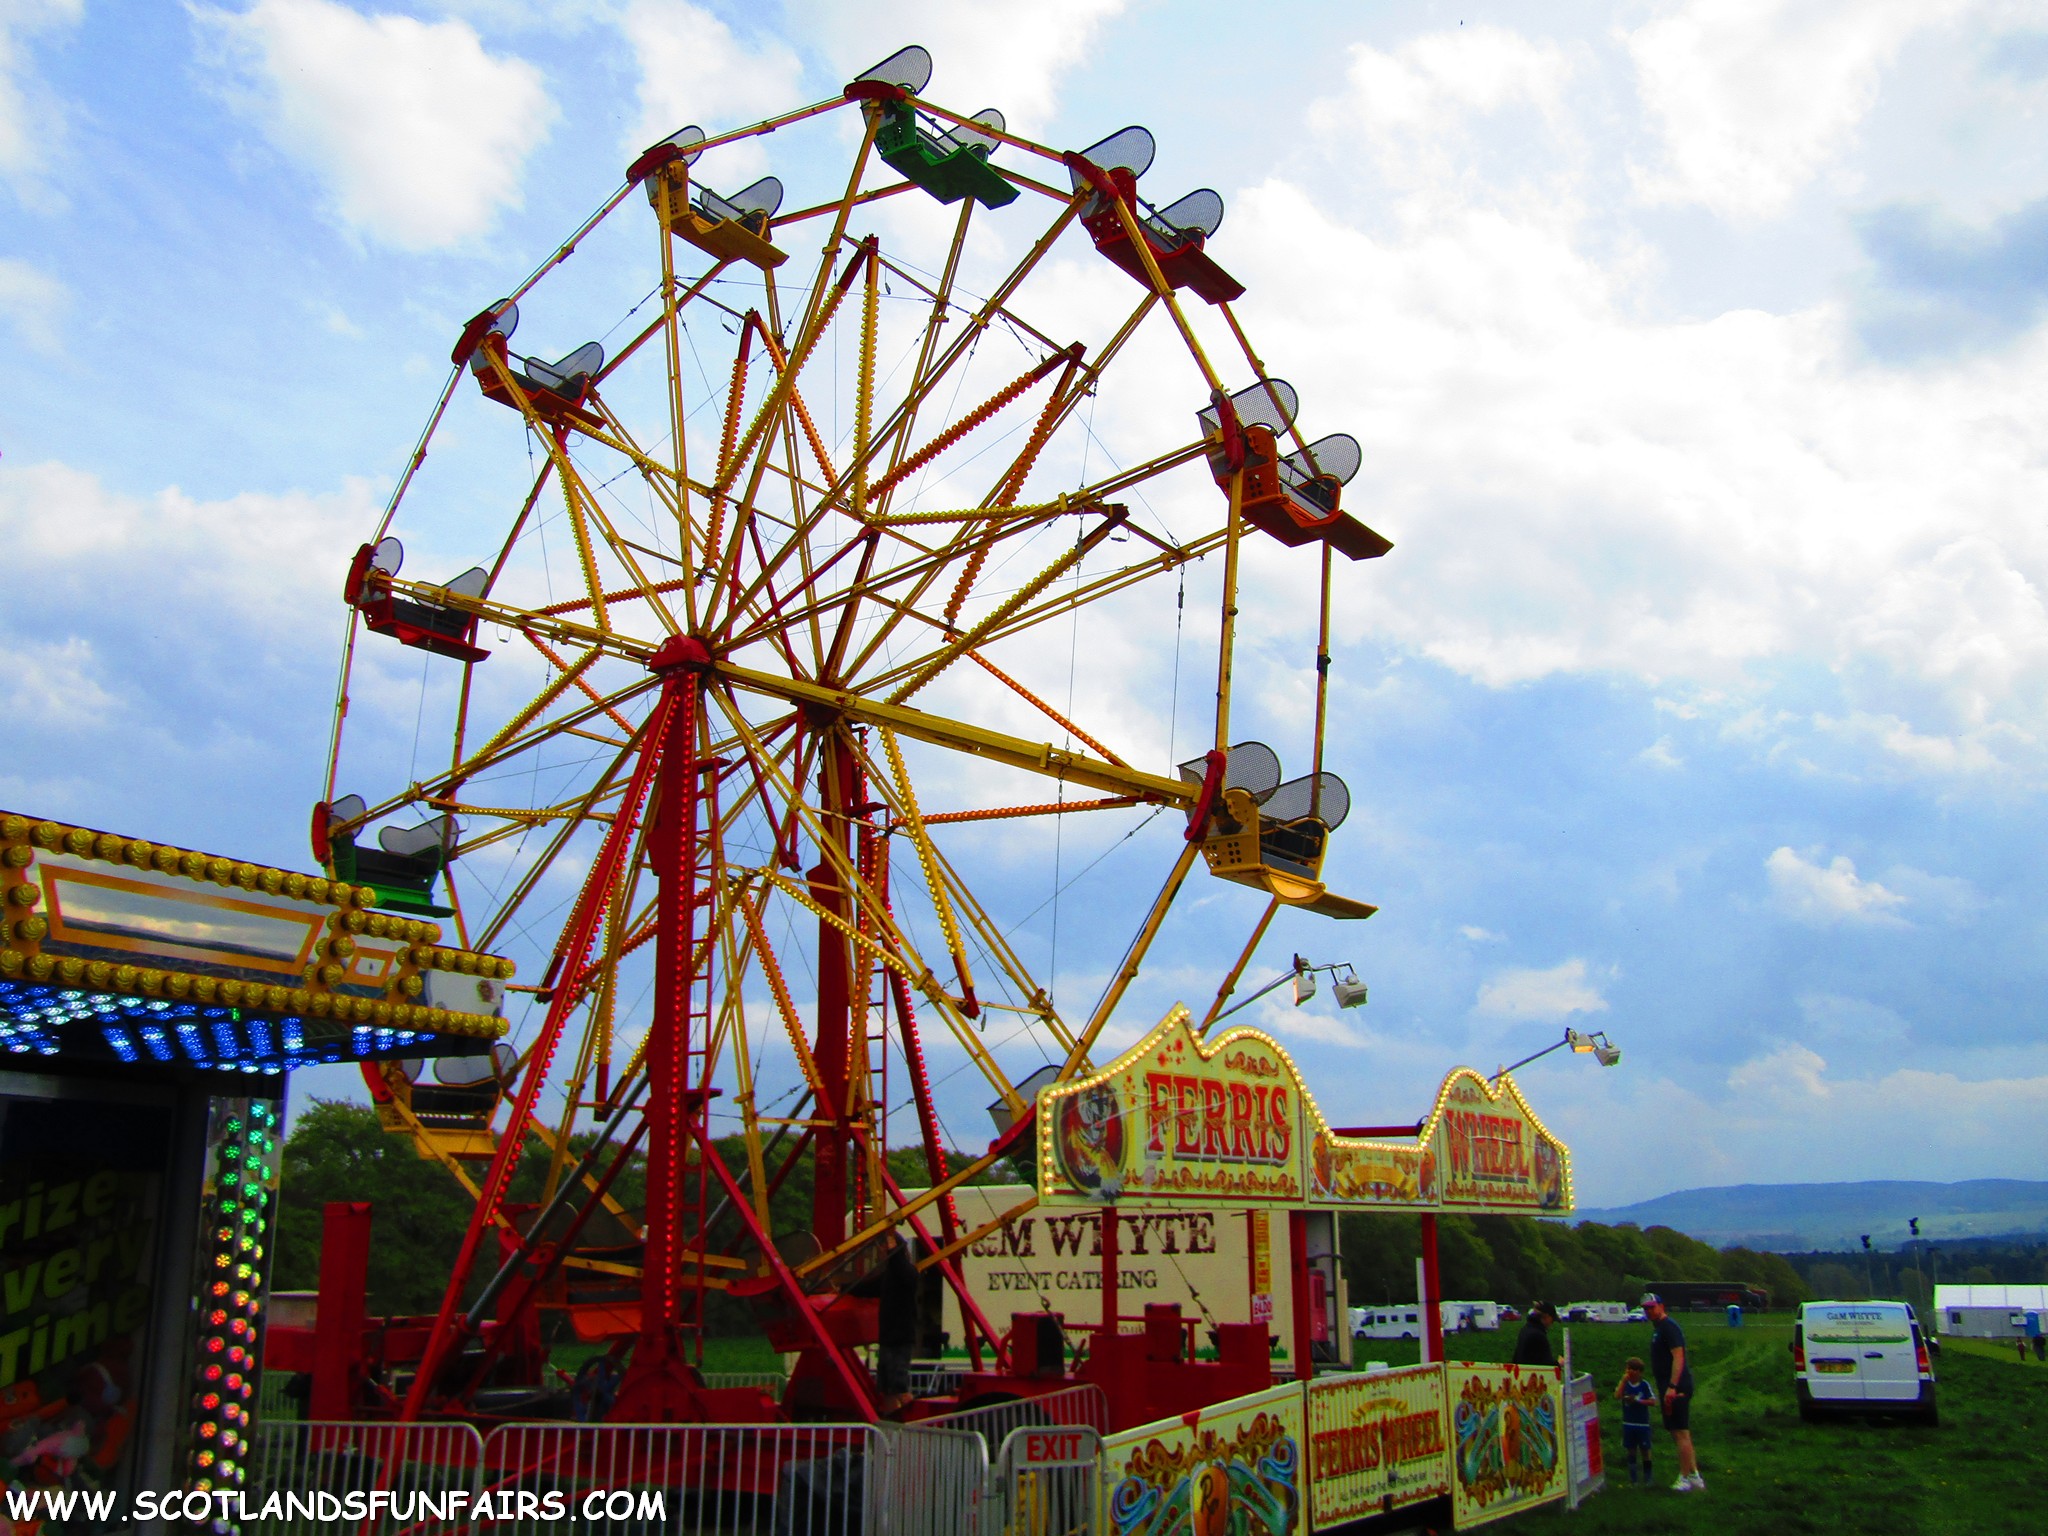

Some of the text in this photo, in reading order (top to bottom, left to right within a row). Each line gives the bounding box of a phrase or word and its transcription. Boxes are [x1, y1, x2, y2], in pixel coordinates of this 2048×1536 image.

[1144, 1072, 1530, 1180] FERRIS WHEEL
[957, 1217, 1036, 1258] &M
[988, 1272, 1052, 1290] EVENT
[0, 1283, 150, 1387] Time
[1849, 1312, 1882, 1320] WHYTE
[1027, 1434, 1082, 1461] EXIT
[1311, 1410, 1445, 1482] FERRIS WHEEL
